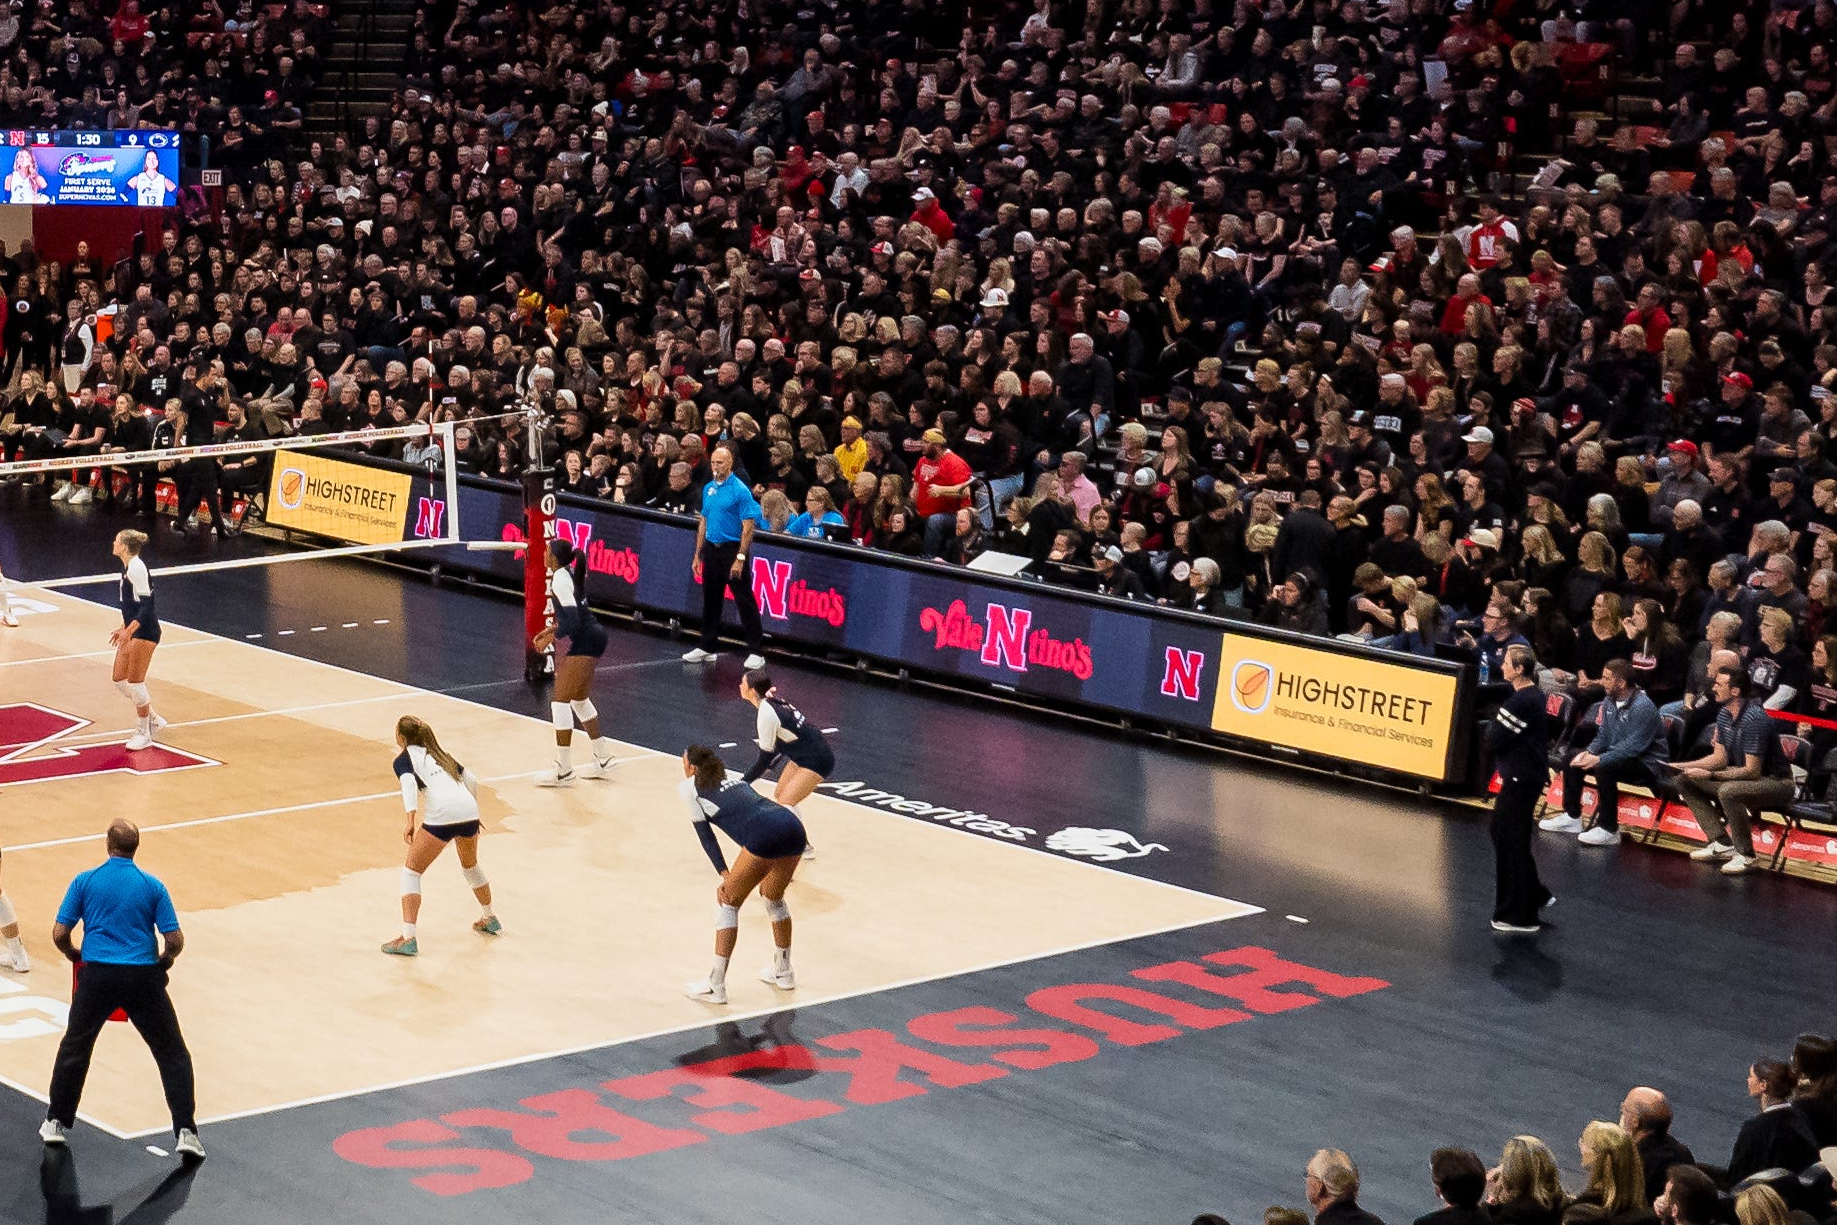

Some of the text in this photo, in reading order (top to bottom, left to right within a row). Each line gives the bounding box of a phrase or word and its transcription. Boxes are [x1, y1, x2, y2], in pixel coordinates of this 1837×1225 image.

[10, 131, 137, 146] N 15 1:30 9
[59, 185, 95, 194] JANUARY
[64, 178, 111, 186] FIRST SERVE
[203, 172, 221, 184] EXIT
[306, 477, 397, 513] HIGHSTREET
[415, 497, 444, 538] N
[1160, 646, 1205, 703] N
[1276, 672, 1433, 725] HIGHSTREET
[1274, 706, 1433, 749] Insurance & Financial Services
[817, 777, 1039, 843] Ameritas
[333, 944, 1391, 1196] HUSKERS
